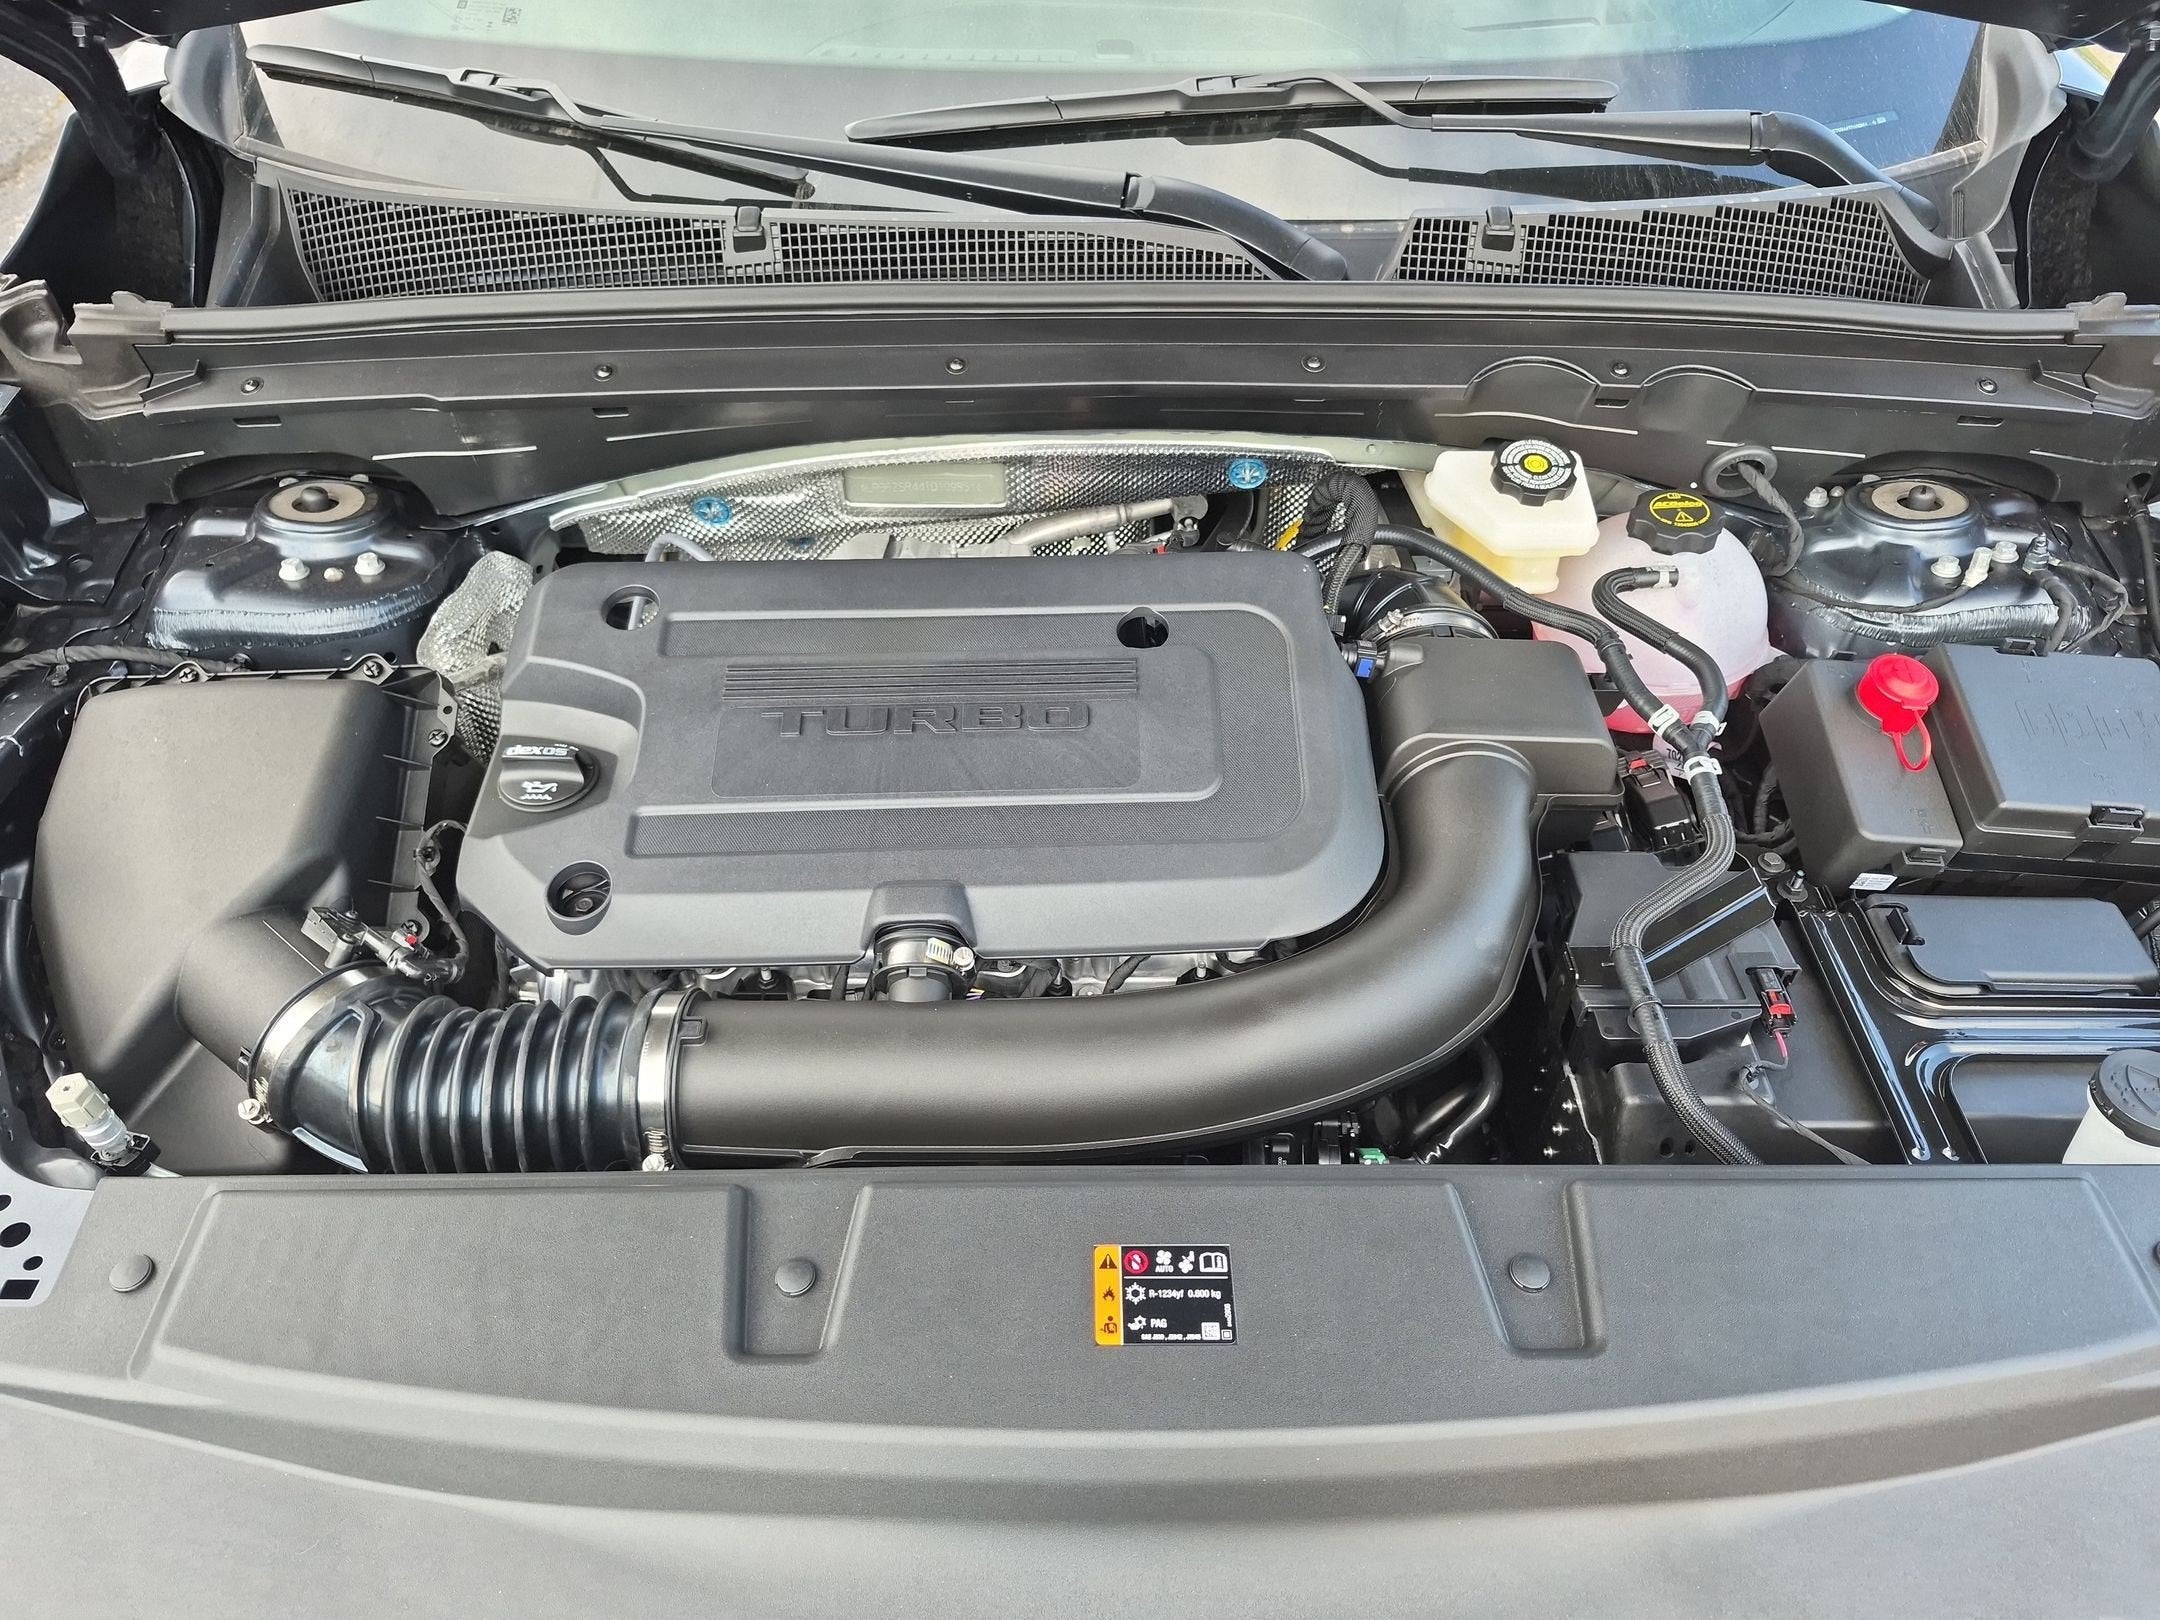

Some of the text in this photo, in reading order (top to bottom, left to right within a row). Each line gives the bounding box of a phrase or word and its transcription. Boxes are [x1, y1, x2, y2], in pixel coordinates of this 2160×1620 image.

[761, 702, 1090, 737] TURBO
[505, 744, 569, 756] dexos
[1155, 1265, 1174, 1273] AUTO
[1149, 1289, 1184, 1299] R-1234yf
[1210, 1289, 1222, 1299] kg
[1150, 1318, 1167, 1328] PAG
